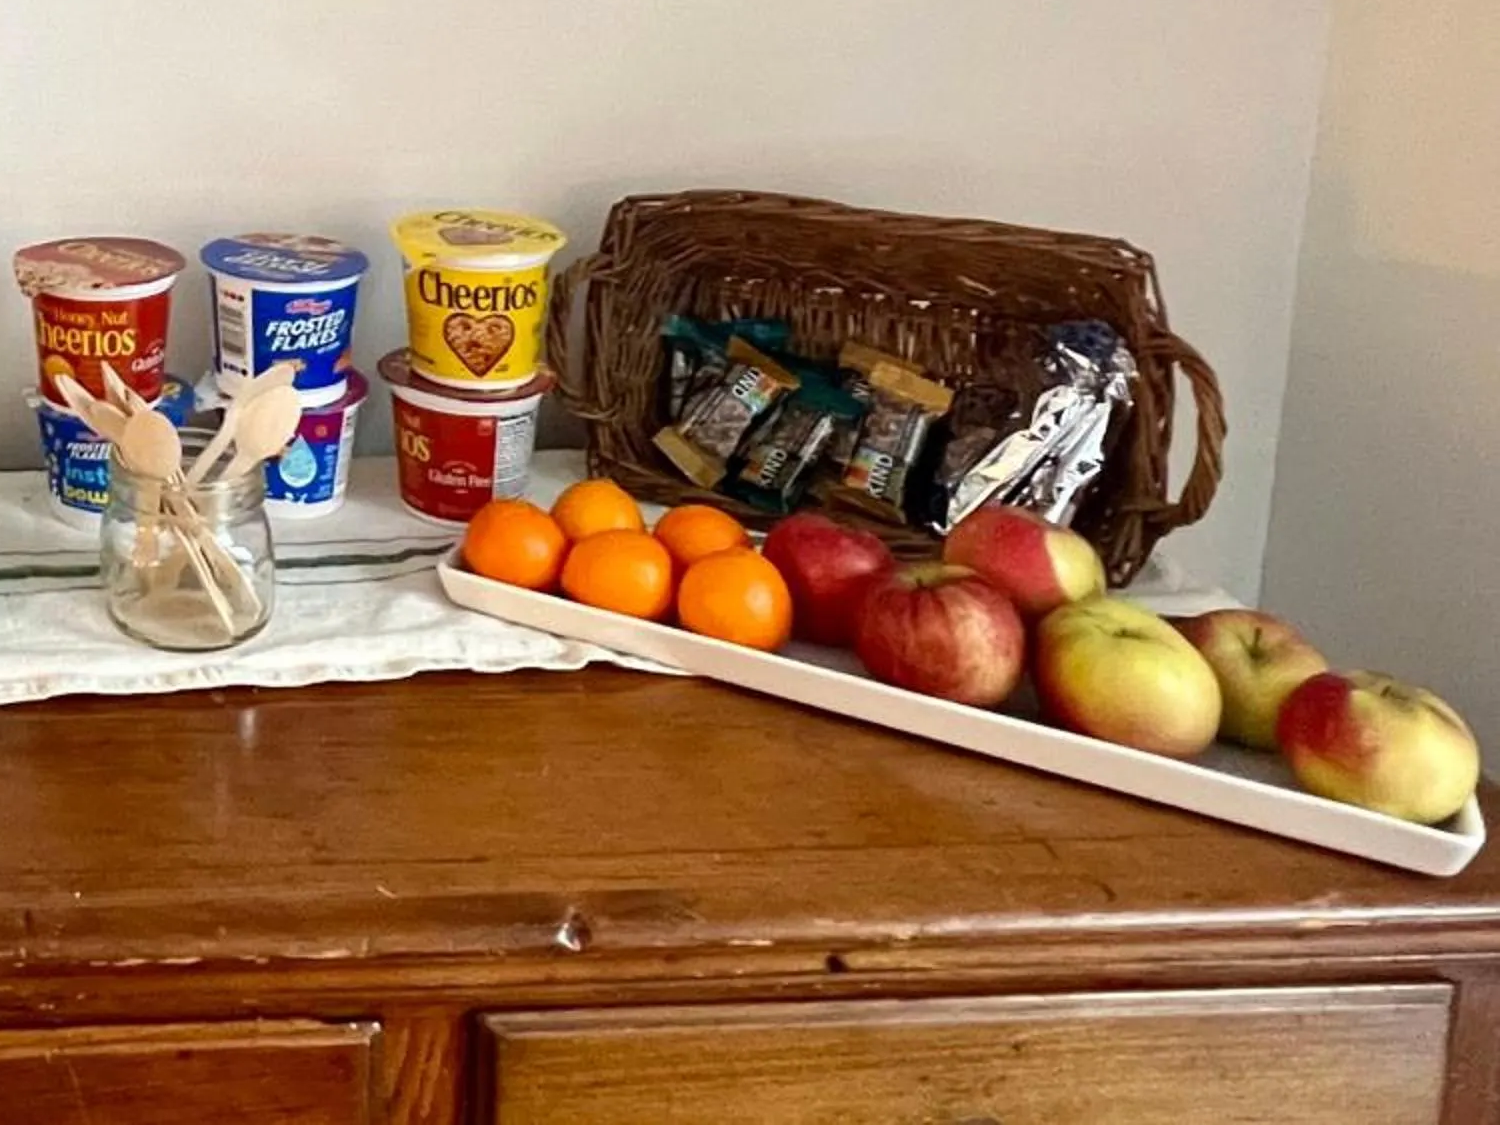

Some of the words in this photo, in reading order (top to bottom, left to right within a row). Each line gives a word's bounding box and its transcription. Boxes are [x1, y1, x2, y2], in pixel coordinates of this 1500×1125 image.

[418, 268, 538, 311] Cheerios
[37, 311, 137, 357] heerios
[101, 311, 129, 326] Nut
[265, 309, 346, 337] FROSTED
[271, 327, 340, 352] FLAKES
[757, 448, 788, 489] KIND
[866, 453, 894, 499] KIND
[63, 477, 110, 505] bow
